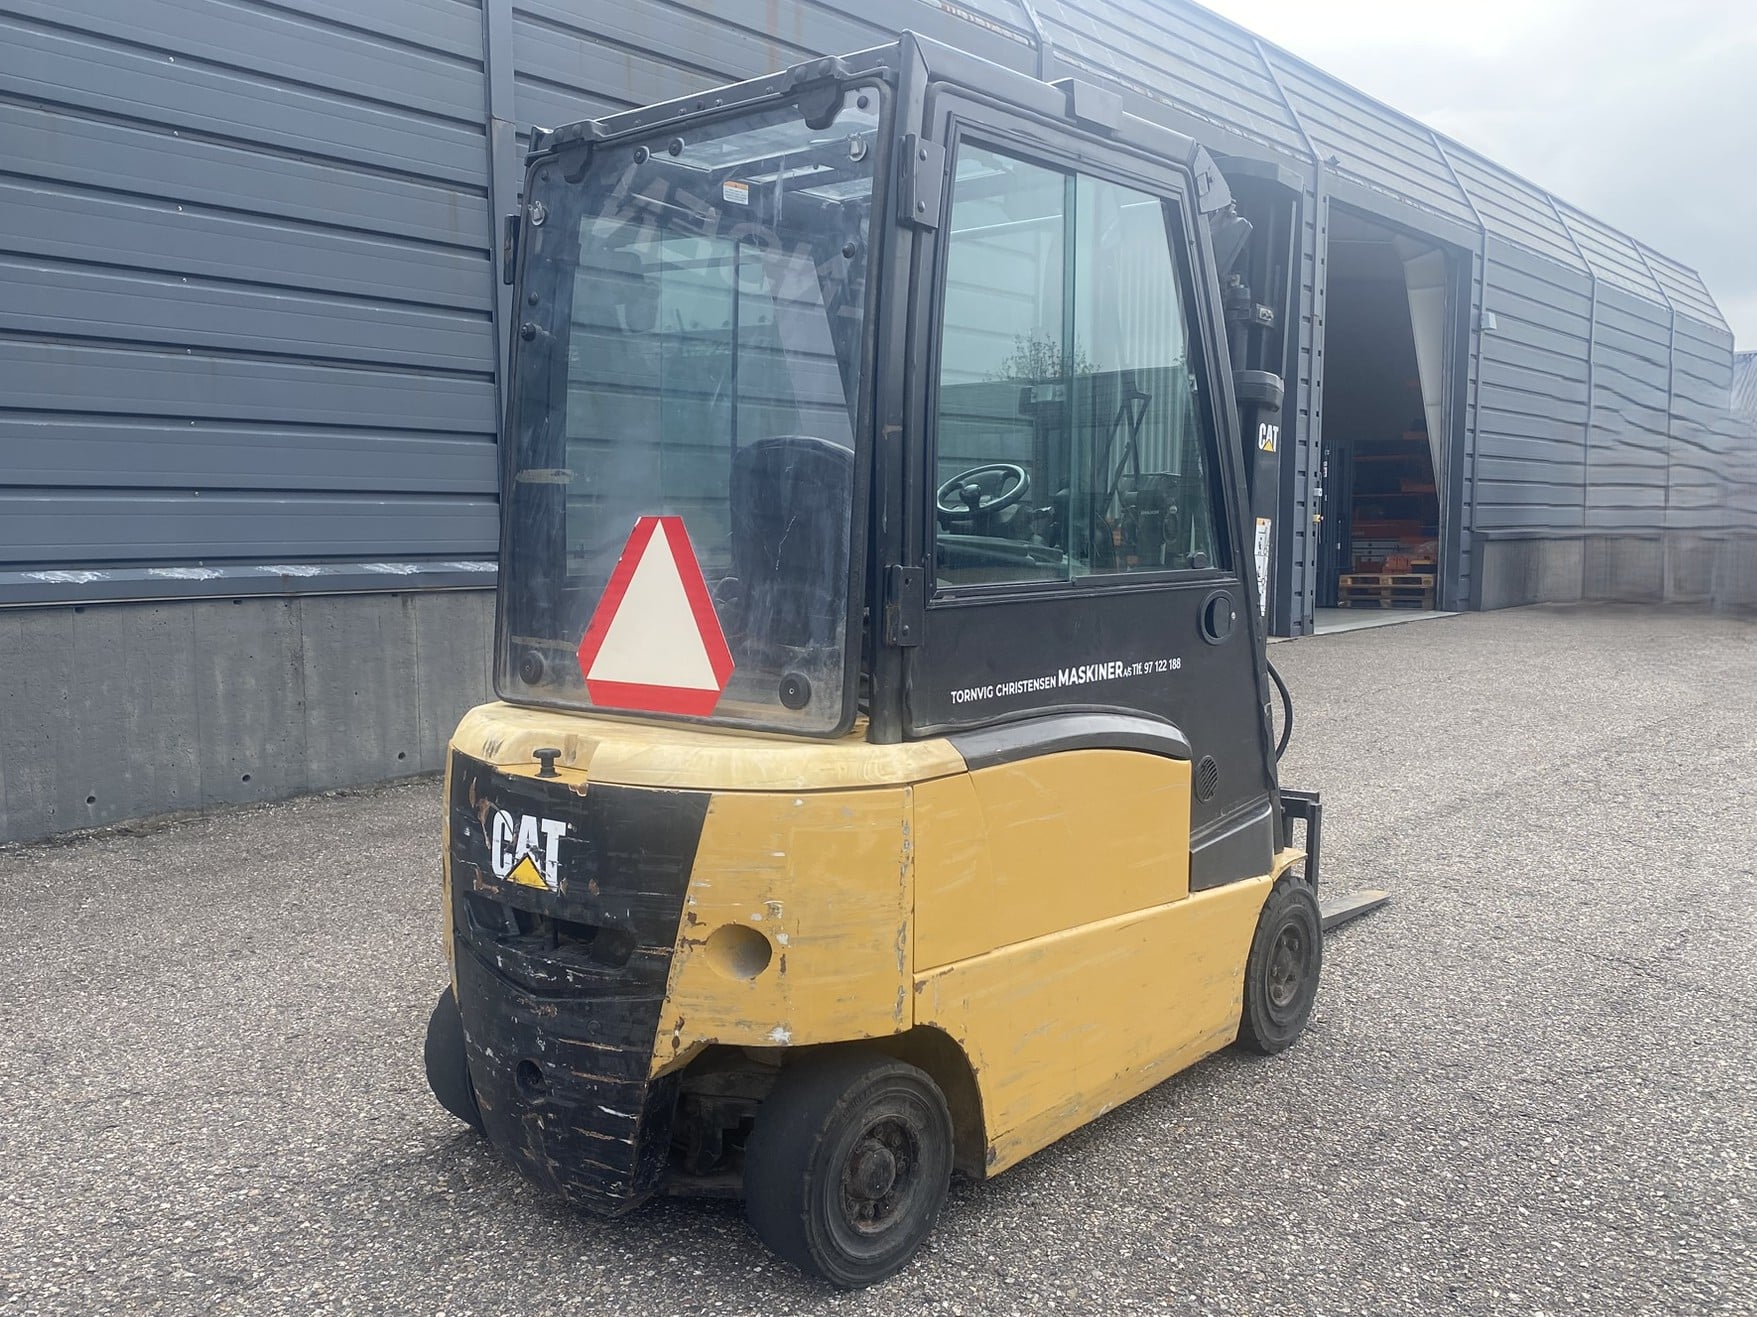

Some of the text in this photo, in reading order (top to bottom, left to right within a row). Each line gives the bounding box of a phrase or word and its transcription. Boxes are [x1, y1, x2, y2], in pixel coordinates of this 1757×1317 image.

[1259, 422, 1279, 453] CAT
[951, 685, 994, 704] TORNVIG
[996, 675, 1057, 697] CHRISTENSEN
[1058, 661, 1123, 687] MASKINER
[1144, 661, 1153, 674] 97
[1155, 659, 1167, 672] 122
[1169, 657, 1181, 670] 188
[492, 809, 567, 893] CAT
